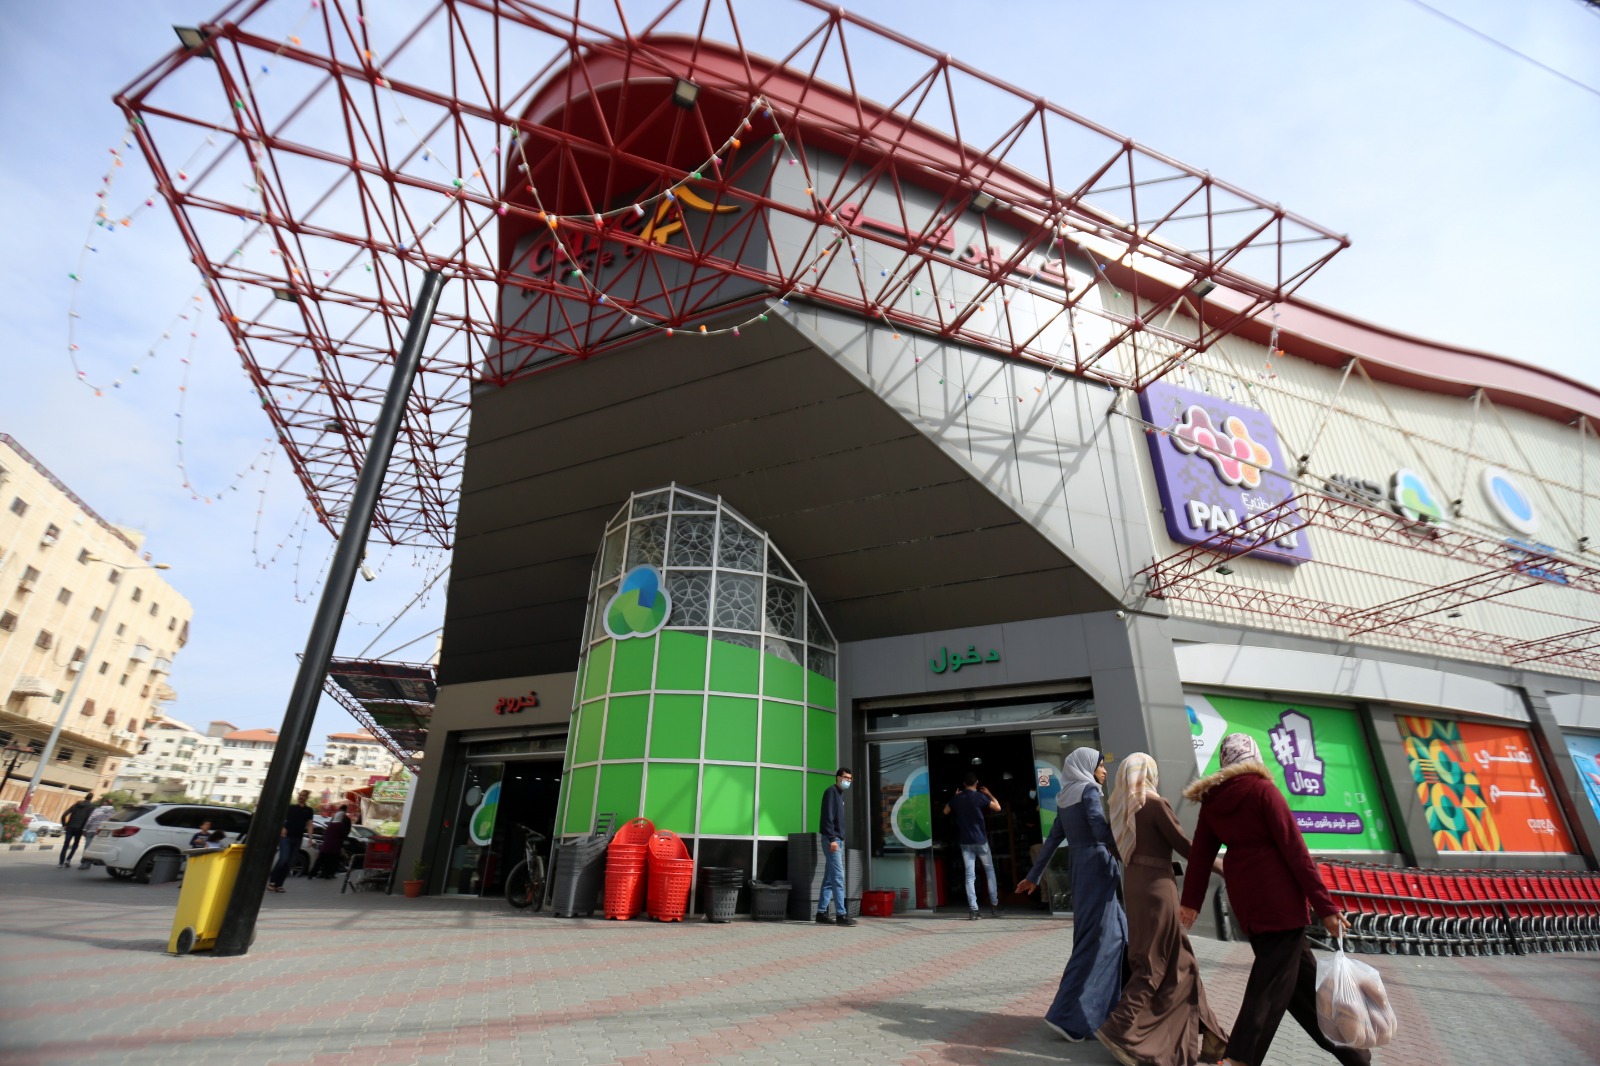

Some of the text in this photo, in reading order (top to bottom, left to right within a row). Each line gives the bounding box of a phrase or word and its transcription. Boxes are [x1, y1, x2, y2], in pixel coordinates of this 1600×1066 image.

[930, 645, 1000, 674] دخول
[493, 691, 538, 715] خروج
[1291, 771, 1320, 794] جوال
[1490, 778, 1548, 803] بكم
